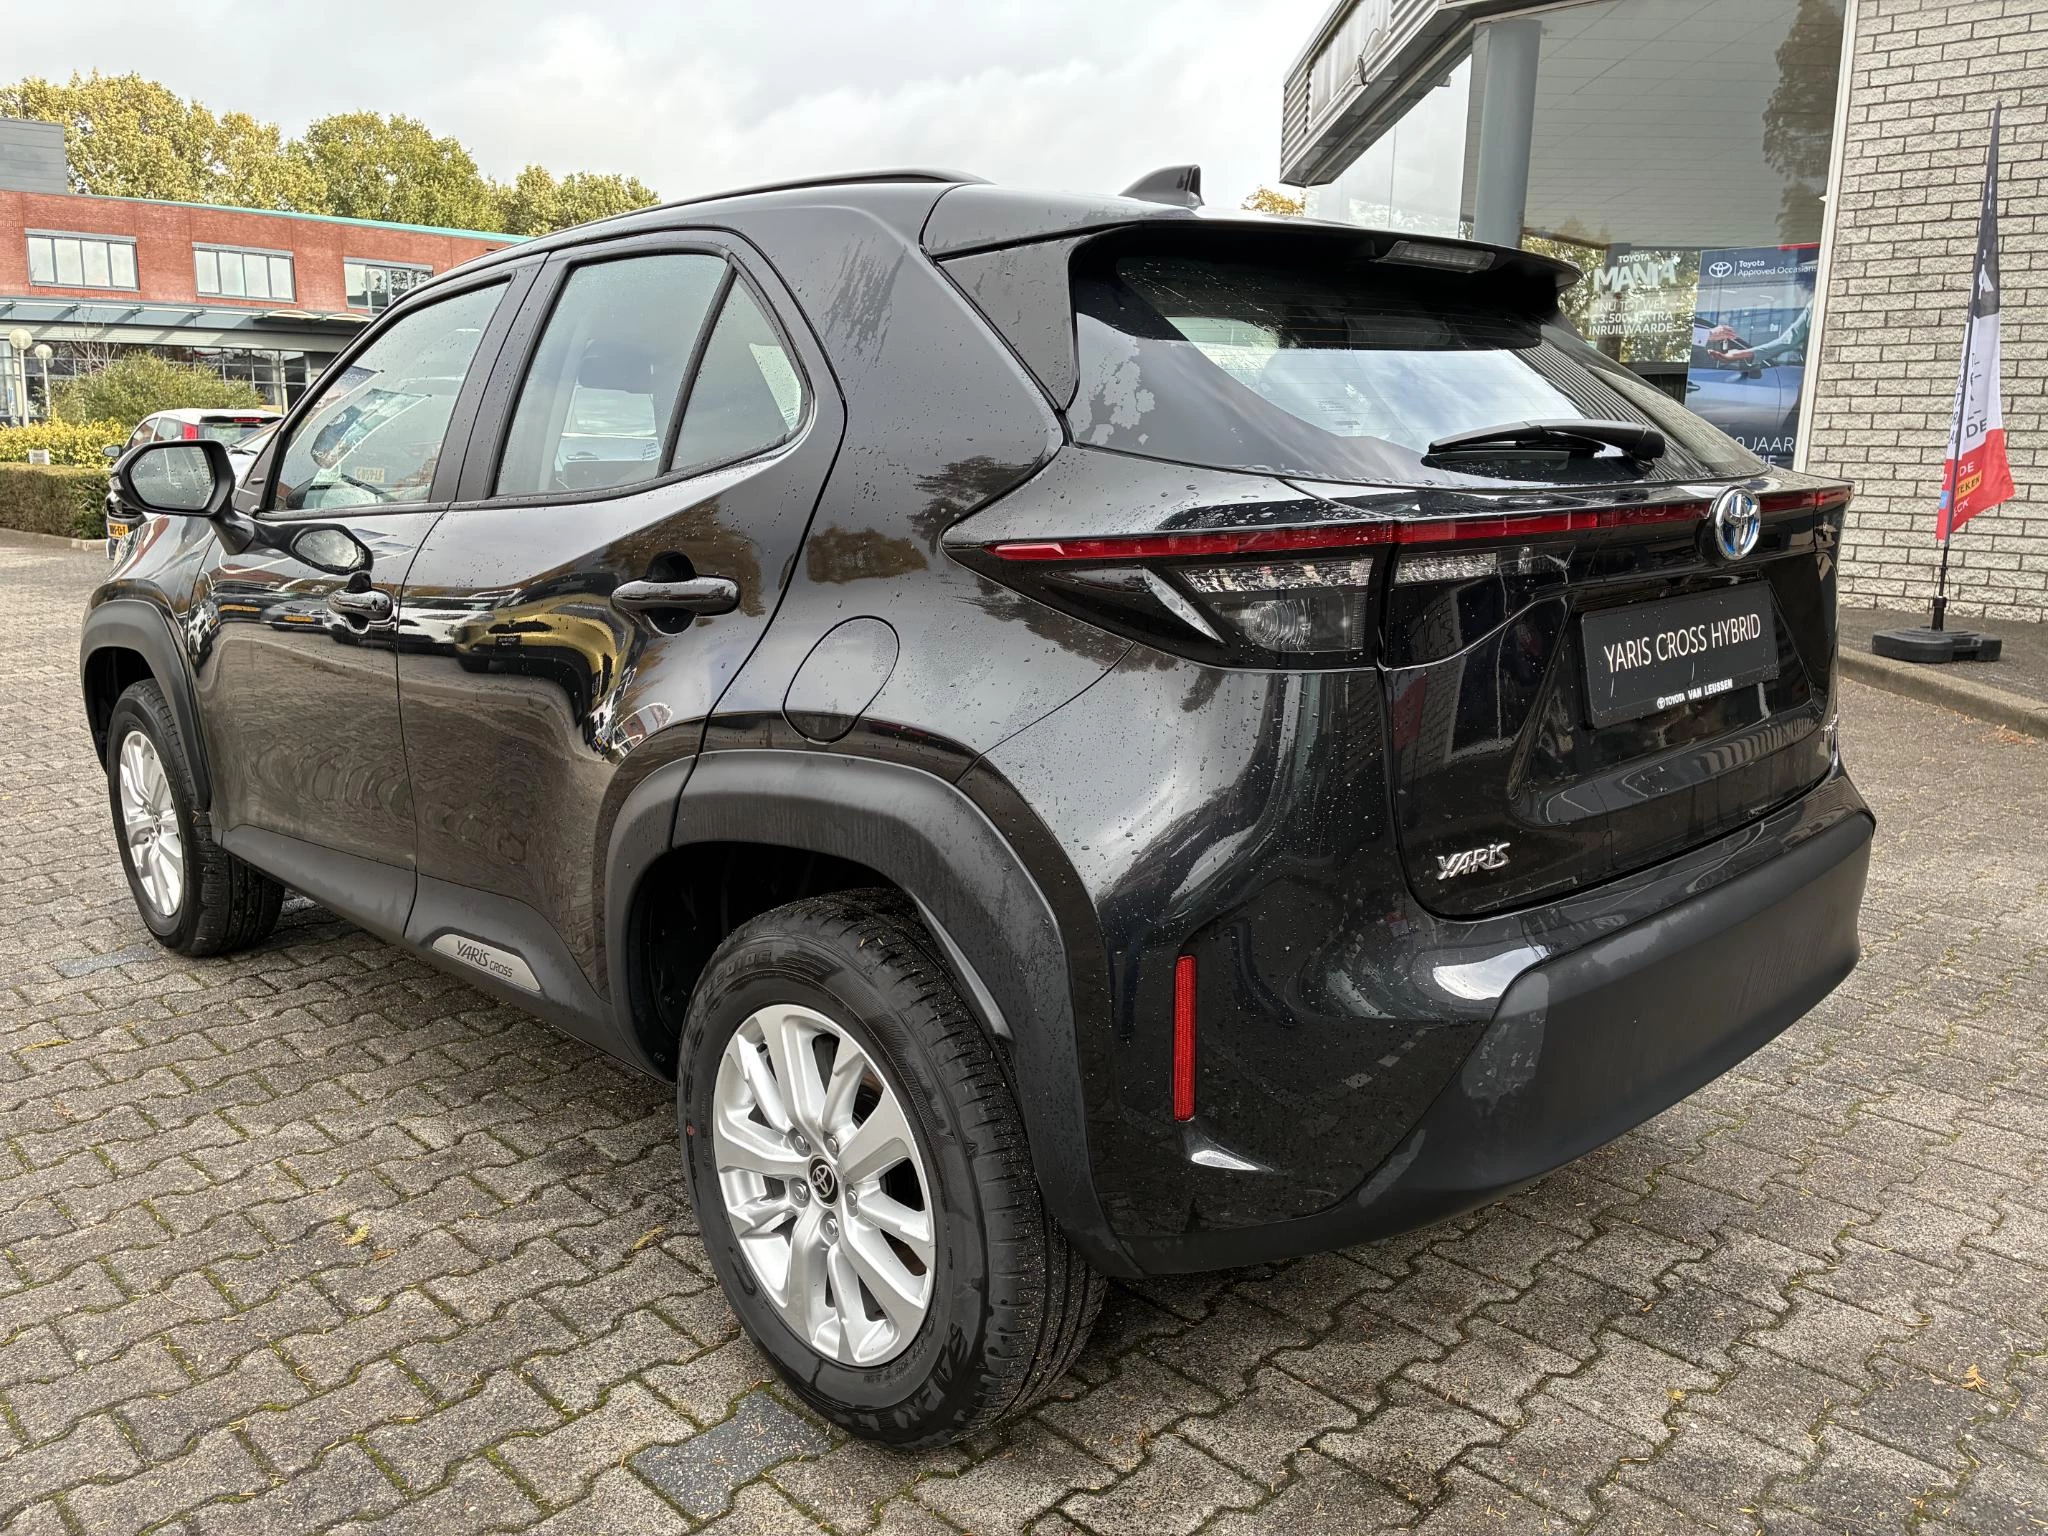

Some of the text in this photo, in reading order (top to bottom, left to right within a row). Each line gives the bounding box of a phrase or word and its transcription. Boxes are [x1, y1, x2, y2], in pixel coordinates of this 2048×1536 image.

[1618, 254, 1651, 263] TOYOTA
[1739, 260, 1765, 269] Toyota
[1593, 260, 1678, 294] MANIA
[1738, 264, 1817, 278] Approved Occasions
[1600, 301, 1617, 313] NU
[1588, 322, 1674, 336] INRUILWAARDE
[1750, 436, 1794, 452] JAAR
[1604, 613, 1761, 673] YARIS CROSS HYBRID
[1665, 678, 1733, 706] TOYOTA VAN LEUSSEN
[489, 958, 513, 978] CROSS
